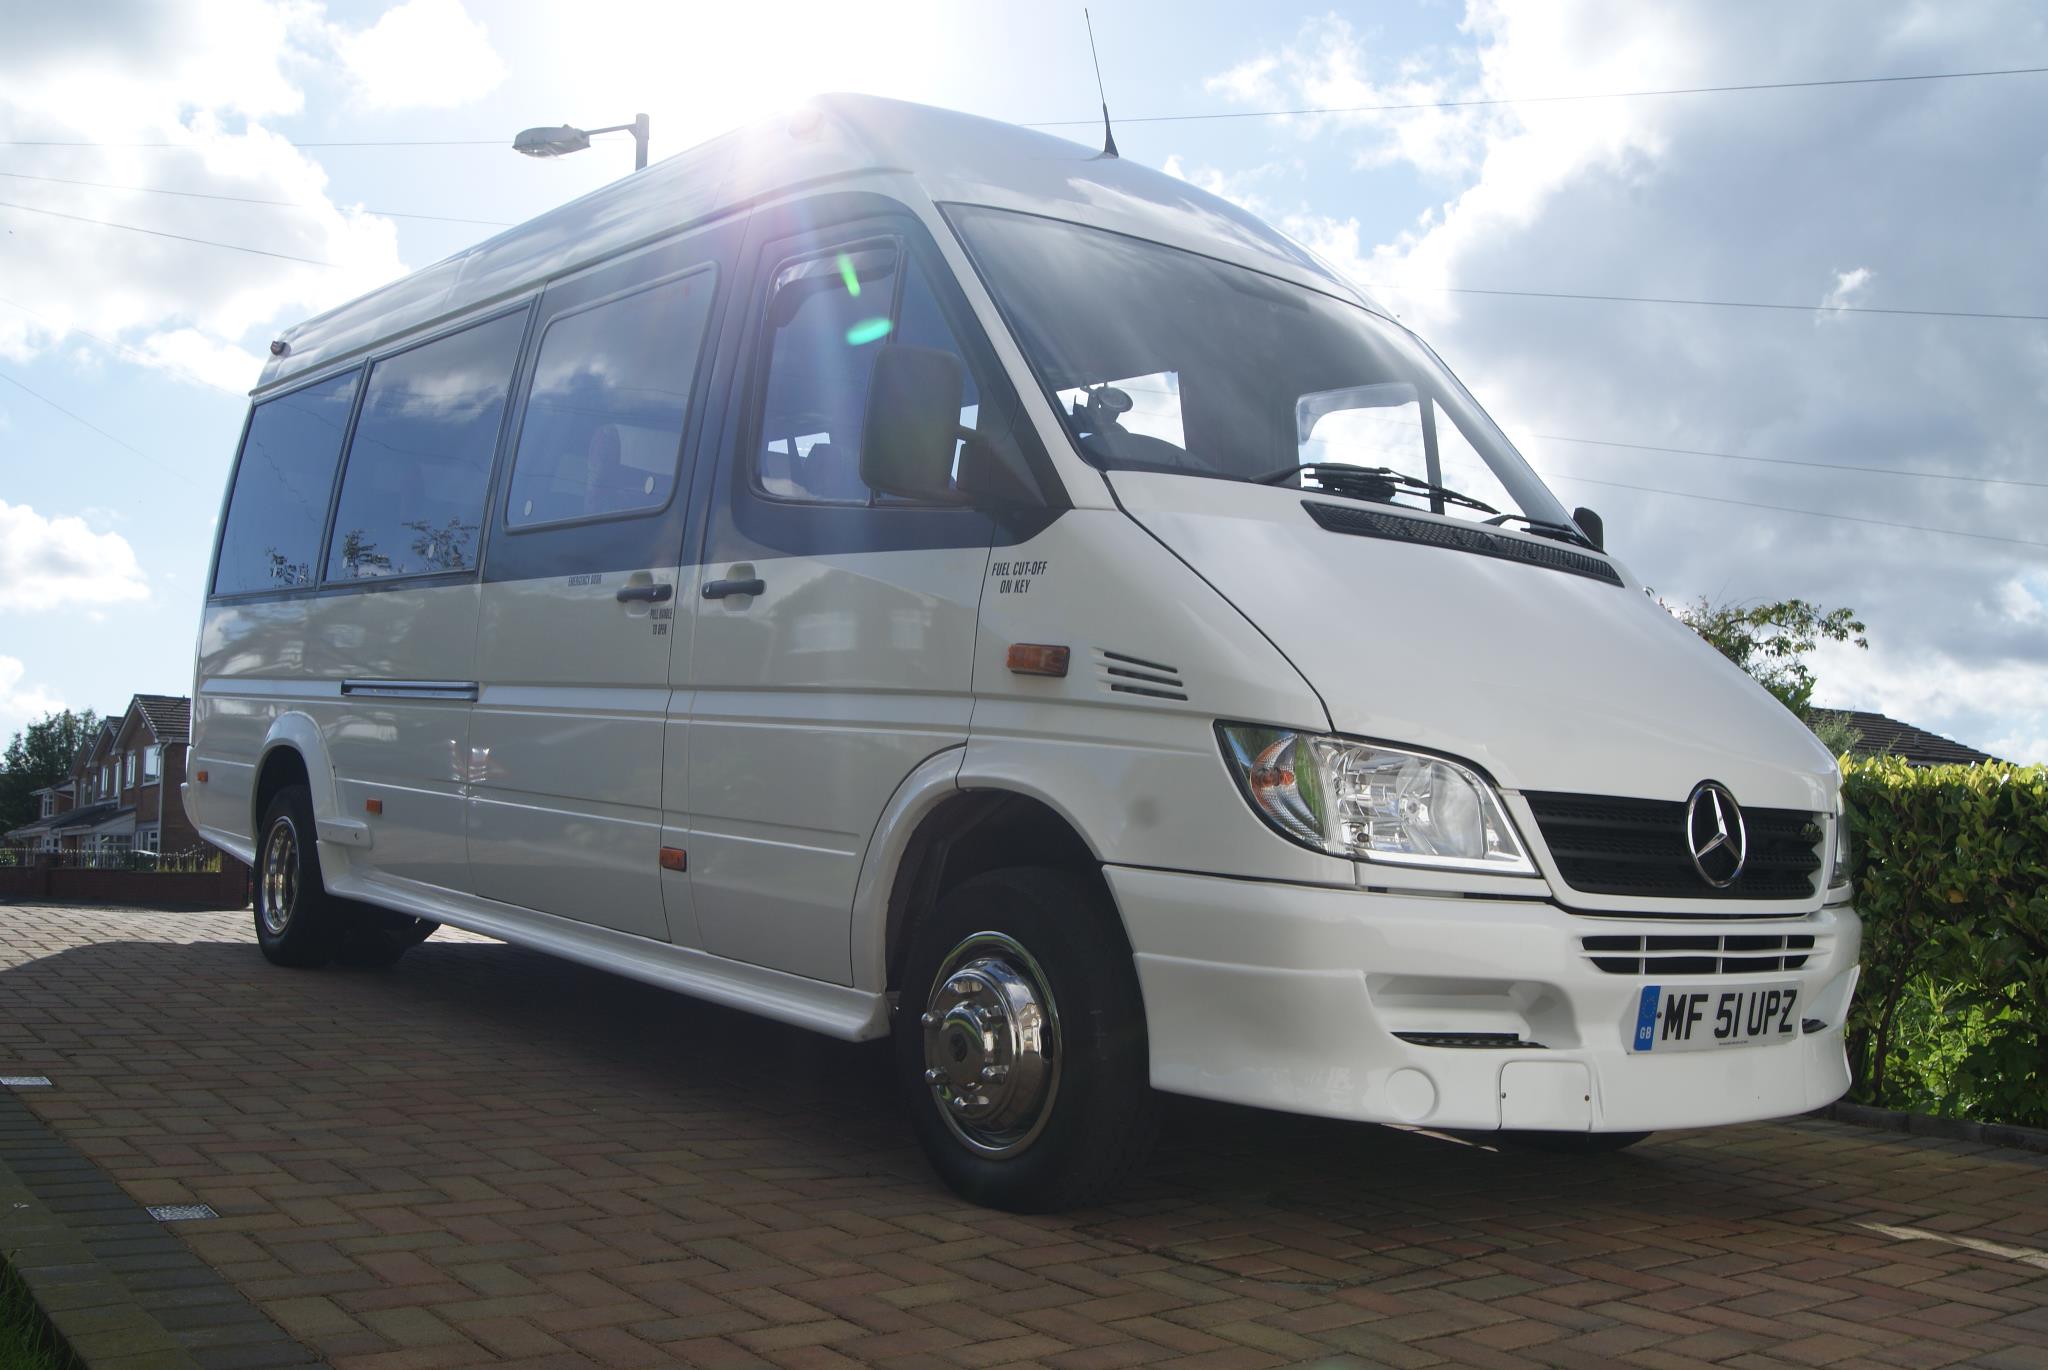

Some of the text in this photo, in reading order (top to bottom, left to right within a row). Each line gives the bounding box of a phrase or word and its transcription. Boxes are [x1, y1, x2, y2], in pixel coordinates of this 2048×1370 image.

[992, 561, 1048, 576] FUEL CUT-OFF
[568, 575, 590, 587] EMERGENCY
[1000, 579, 1031, 593] ON KEY
[1662, 993, 1709, 1040] MF
[1640, 1026, 1652, 1039] GB
